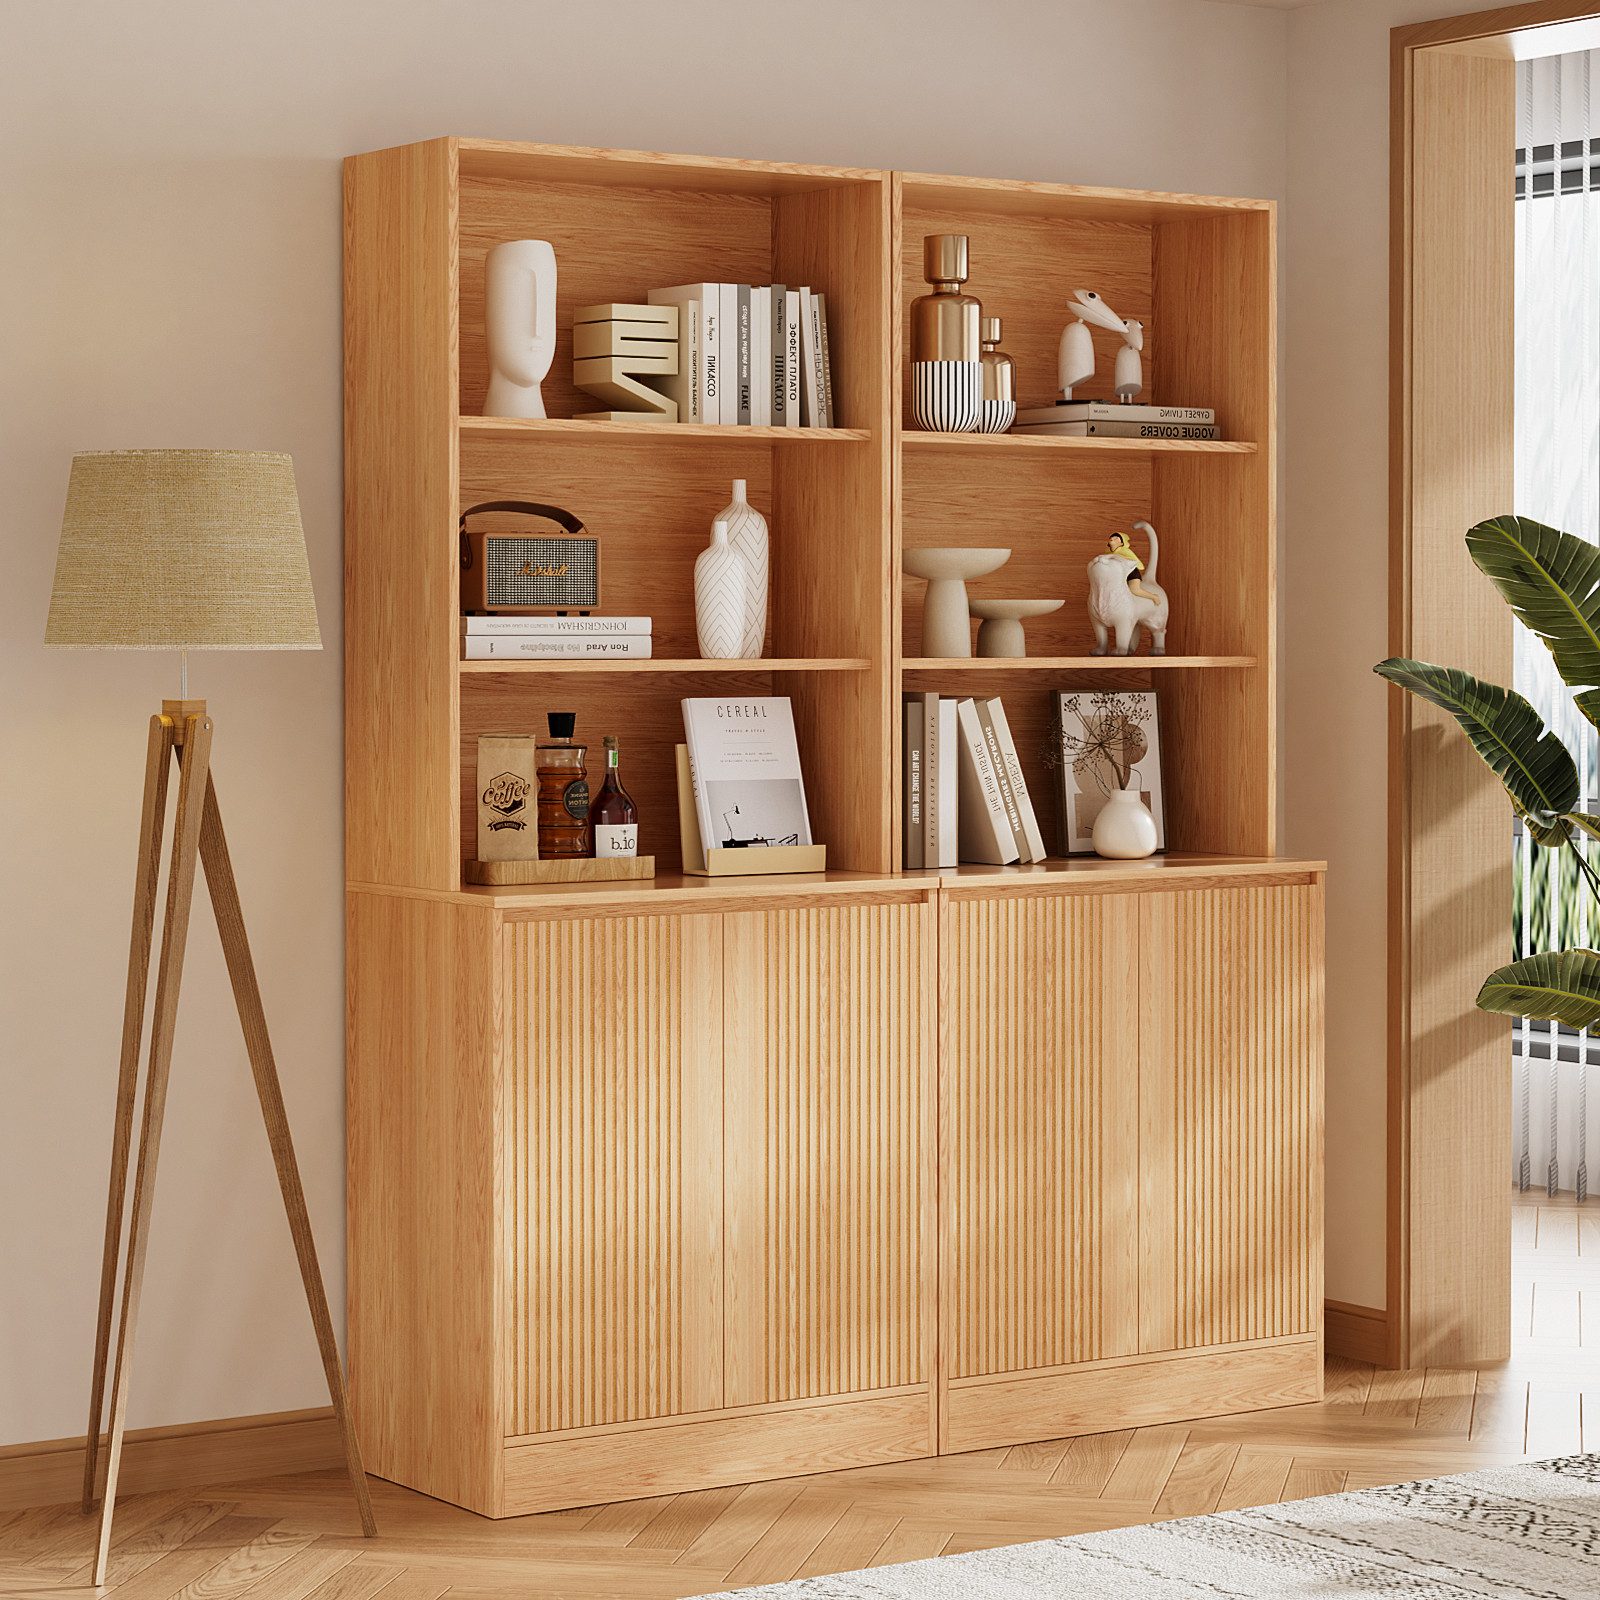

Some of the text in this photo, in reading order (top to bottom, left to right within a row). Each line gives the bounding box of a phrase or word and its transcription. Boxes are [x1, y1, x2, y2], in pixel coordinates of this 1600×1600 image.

[789, 322, 797, 401] ЭФФЕКТ ПЛАТО
[707, 355, 716, 398] ПИКАССО
[774, 354, 784, 412] ПИКАССО
[741, 384, 749, 411] FLAKE
[586, 643, 608, 652] Arad
[610, 643, 629, 652] Ron
[717, 705, 767, 718] CEREAL
[911, 750, 920, 761] CAN
[911, 772, 920, 792] CHANGE
[482, 780, 530, 806] Coffee
[911, 793, 920, 803] THE
[610, 836, 635, 850] b.io
